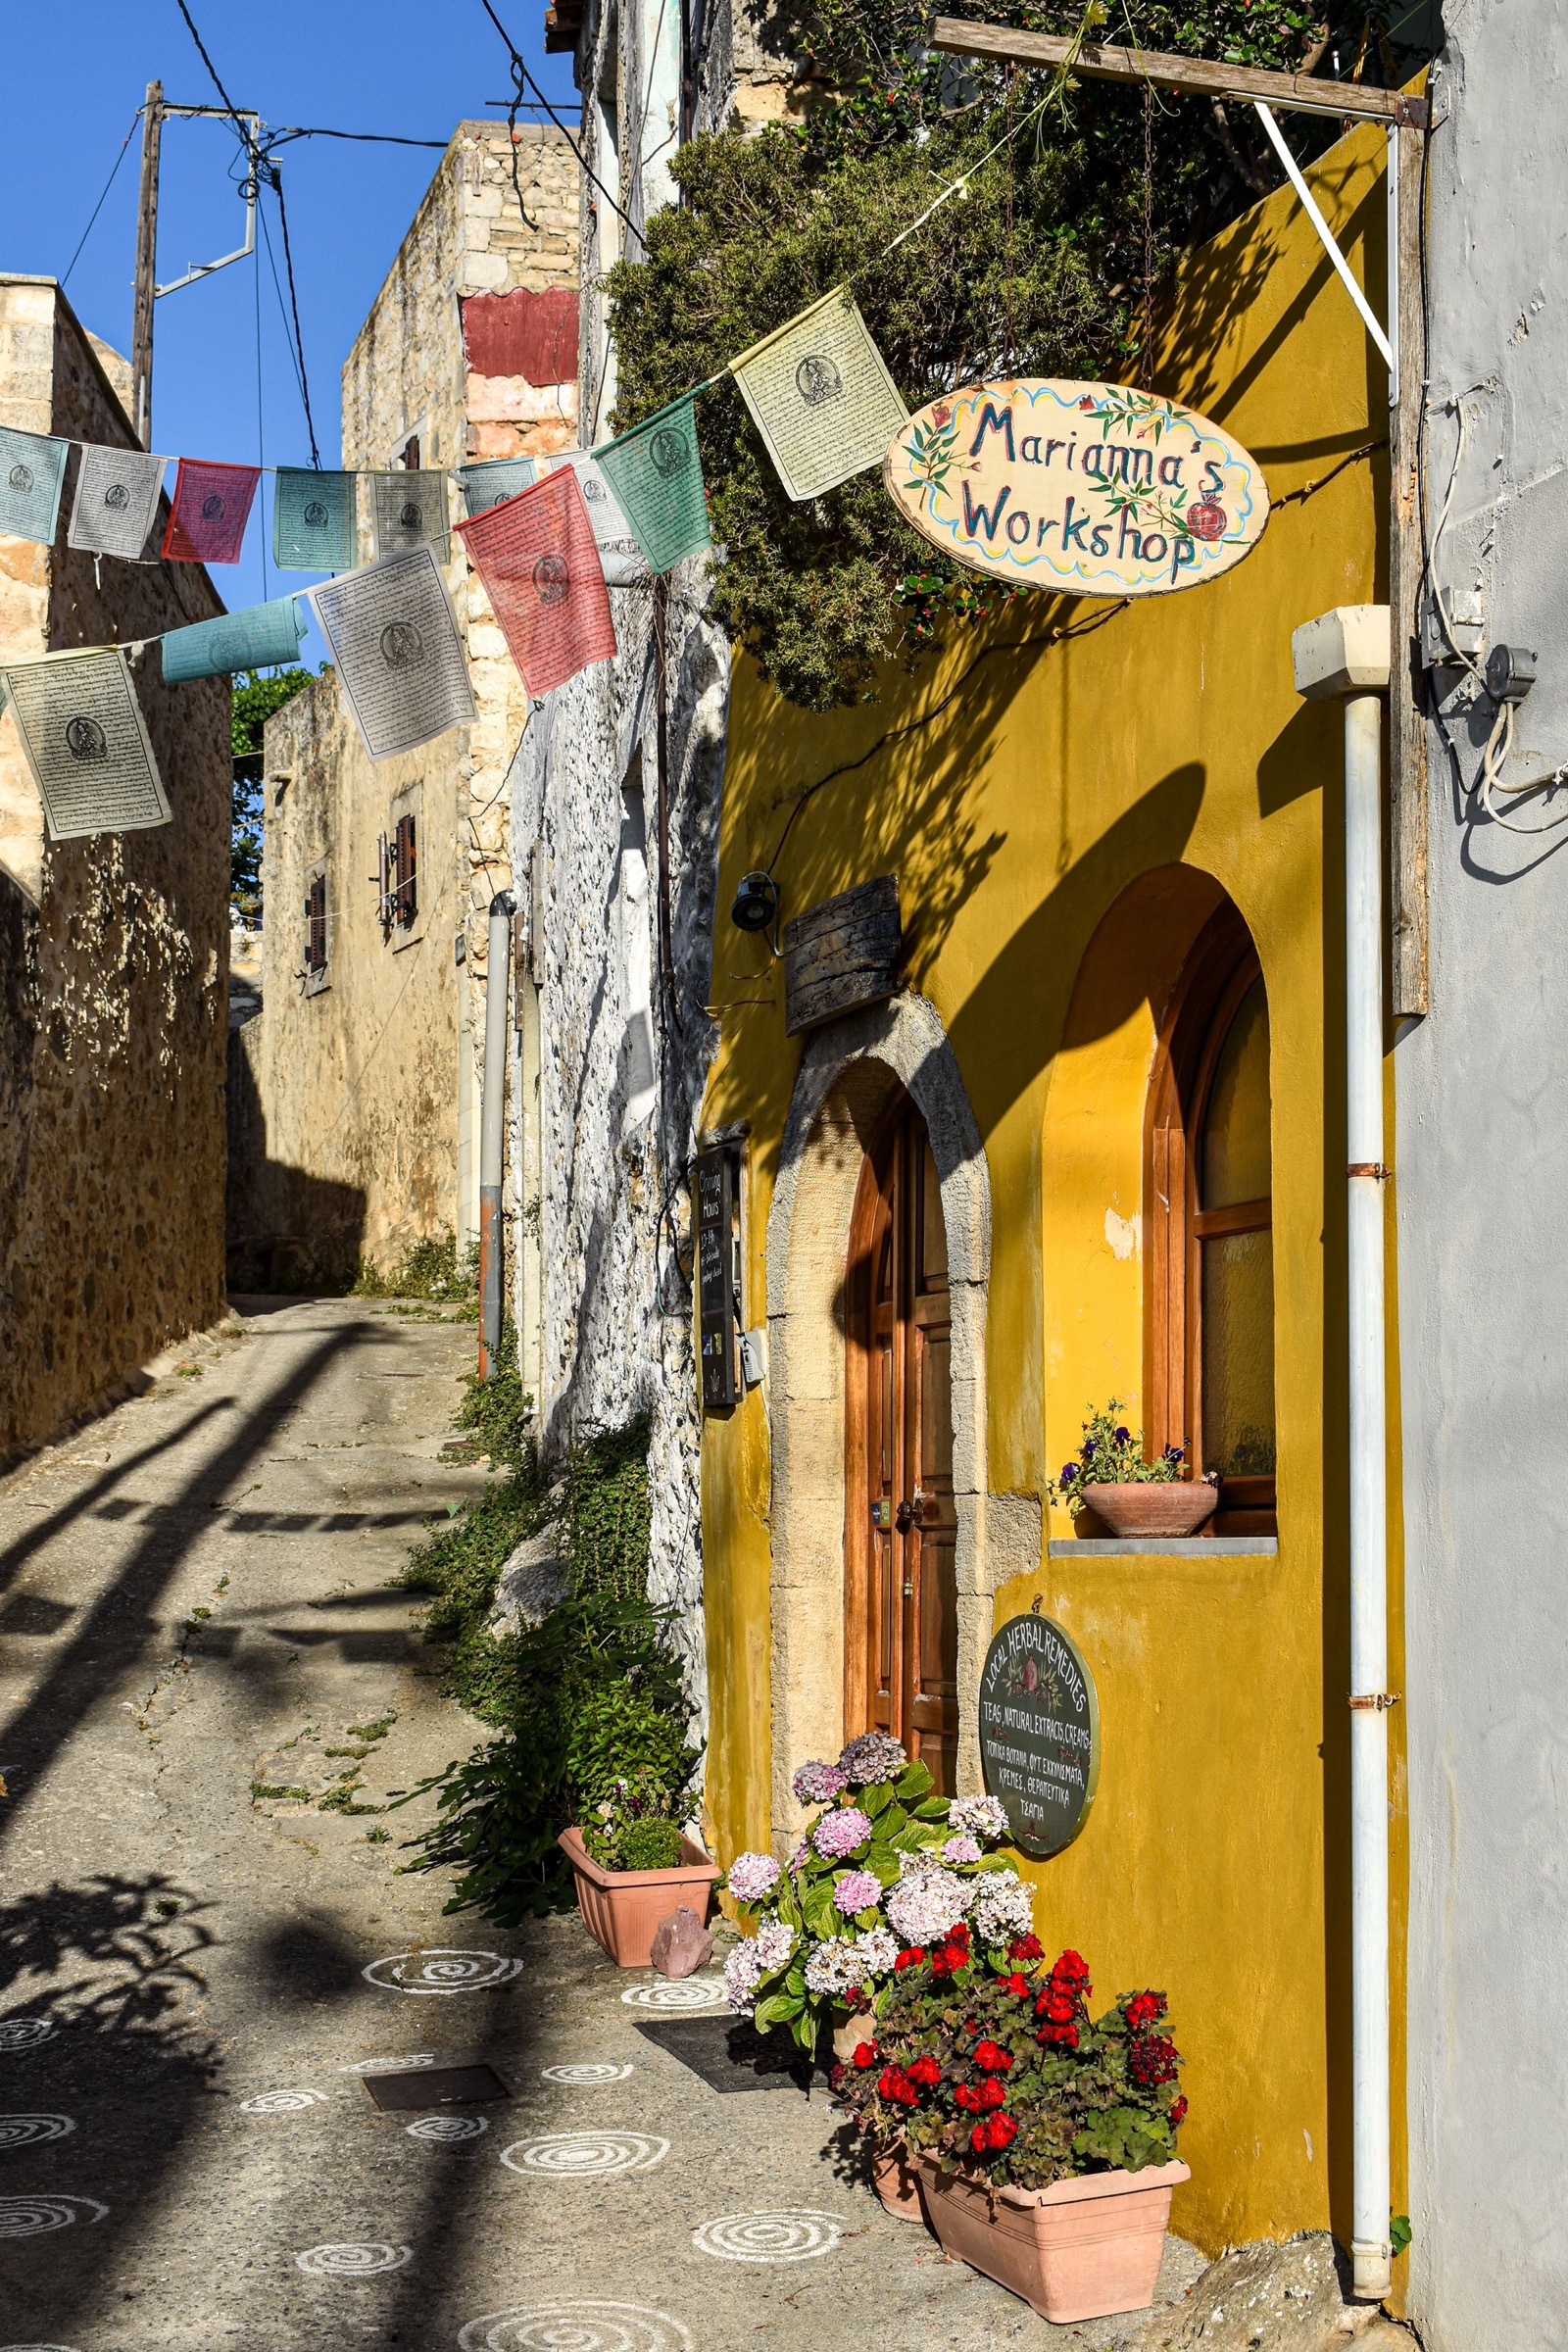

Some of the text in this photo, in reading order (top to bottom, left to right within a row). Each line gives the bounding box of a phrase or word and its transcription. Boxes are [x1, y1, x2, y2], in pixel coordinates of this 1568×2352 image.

[968, 402, 1224, 493] Marianna's
[961, 478, 1196, 585] Workshop
[986, 1622, 1087, 1713] LOCAL HERBAL REMEDIES
[1004, 1706, 1034, 1734] NATURAL
[1020, 1798, 1045, 1821] ΤΣΑΓΙΑ
[1027, 1776, 1070, 1809] ΘΕΡΑΠΕΥΤΙΚΑ
